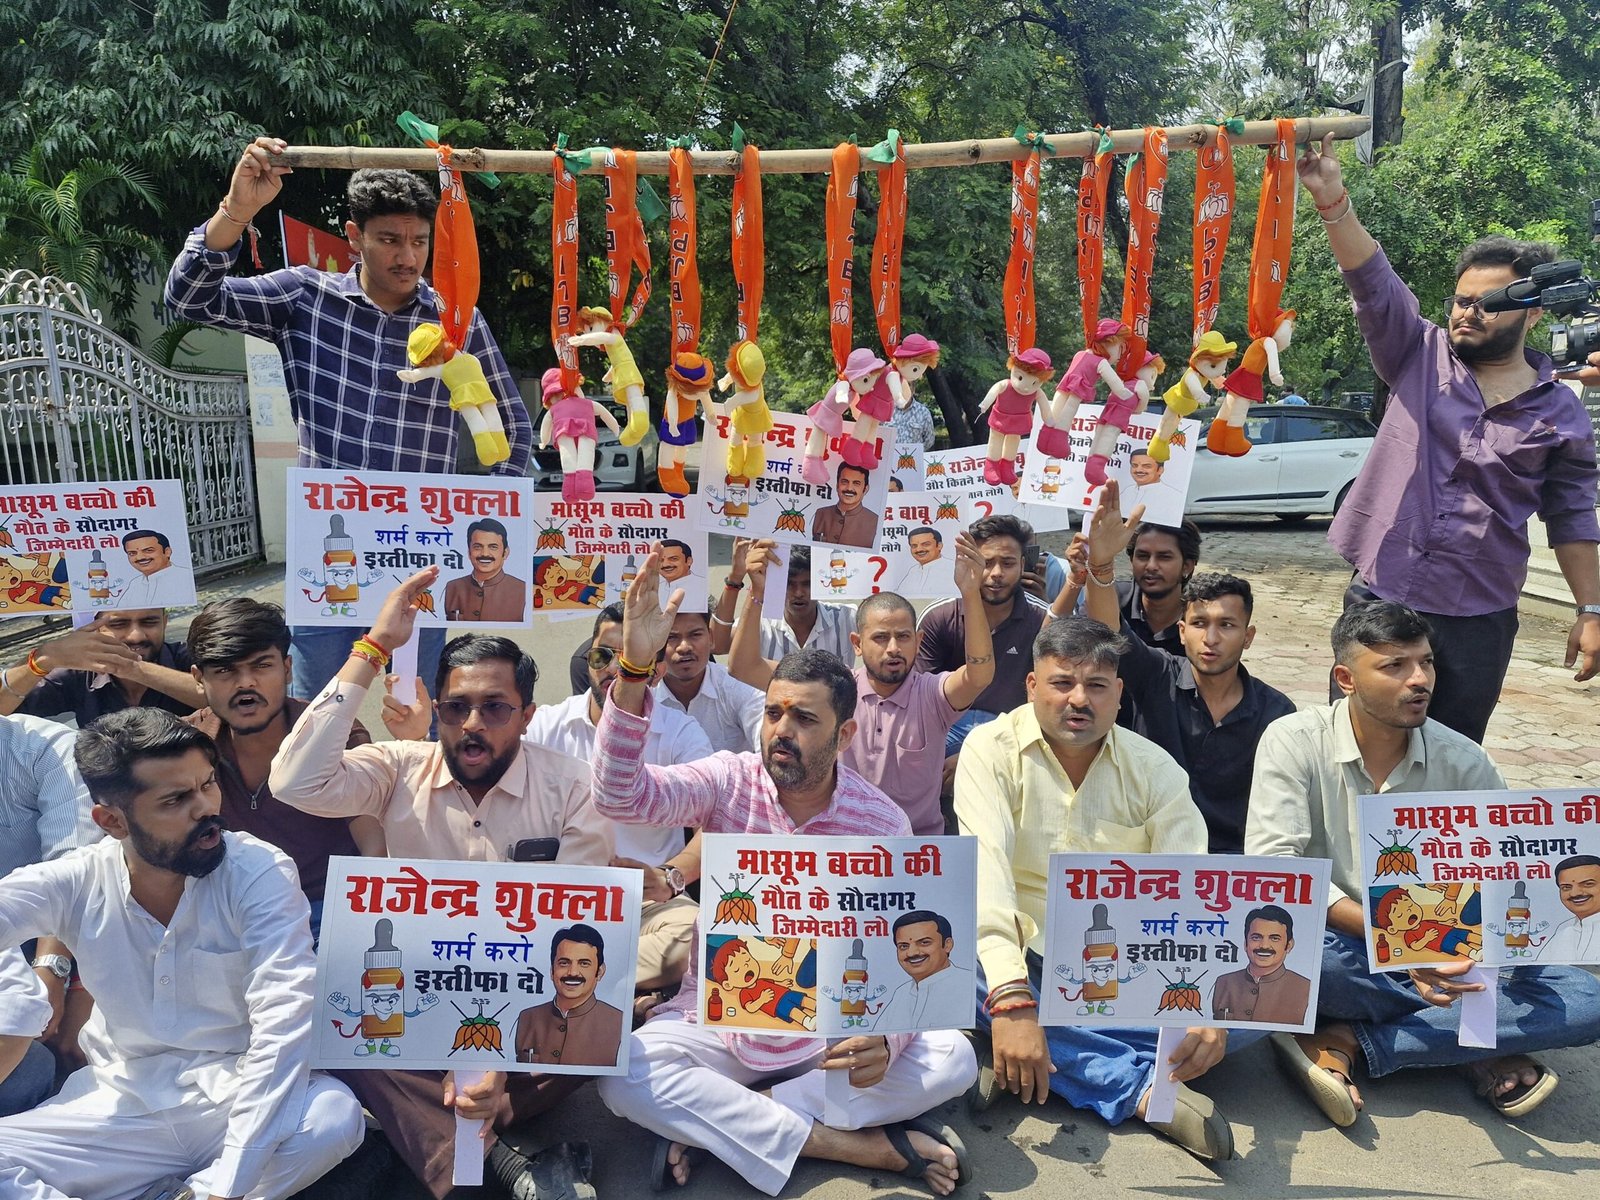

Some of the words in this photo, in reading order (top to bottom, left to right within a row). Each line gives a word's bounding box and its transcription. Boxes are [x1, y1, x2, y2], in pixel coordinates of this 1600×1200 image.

[766, 457, 793, 475] शर्म
[755, 476, 811, 497] इस्तीफा
[816, 482, 833, 500] दो
[946, 475, 974, 489] कितने
[985, 487, 1004, 497] लोगे
[63, 488, 118, 511] बच्चो
[123, 486, 157, 508] की
[303, 475, 409, 514] राजेन्द्र
[419, 487, 521, 525] शुक्ला
[551, 501, 605, 523] मासूम
[611, 498, 653, 519] बच्चो
[659, 499, 686, 519] की
[13, 519, 49, 535] मौत
[53, 518, 71, 534] के
[75, 516, 139, 533] सौदागर
[898, 505, 933, 525] बाबू
[26, 535, 96, 552] जिम्मेदारी
[99, 534, 121, 548] लो
[375, 524, 409, 546] शर्म
[416, 526, 453, 547] करो
[567, 523, 595, 538] मौत
[599, 523, 613, 538] के
[617, 523, 668, 539] सौदागर
[882, 524, 909, 540] ासूमो
[364, 547, 436, 570] इस्तीफा
[443, 550, 465, 570] दो
[575, 541, 631, 554] जिम्मेदारी
[881, 542, 901, 553] लोगे
[867, 556, 888, 594] ?
[1393, 805, 1478, 837] मासूम
[1486, 796, 1554, 827] बच्चो
[1563, 794, 1600, 824] की
[1420, 837, 1463, 859] मौत
[1470, 836, 1492, 858] के
[1499, 835, 1577, 857] सौदागर
[737, 849, 818, 885] मासूम
[826, 844, 894, 877] बच्चो
[903, 844, 942, 876] की
[1433, 862, 1520, 882] जिम्मेदारी
[1526, 860, 1551, 879] लो
[1065, 859, 1182, 901] राजेन्द्र
[1194, 869, 1313, 912] शुक्ला
[346, 866, 480, 918] राजेन्द्र
[496, 881, 625, 933] शुक्ला
[761, 885, 802, 910] मौत
[808, 886, 830, 911] के
[837, 887, 916, 911] सौदागर
[772, 914, 858, 937] जिम्मेदारी
[864, 916, 889, 937] लो
[1141, 912, 1180, 937] शर्म
[1186, 914, 1229, 937] करो
[431, 932, 478, 961] शर्म
[485, 934, 533, 963] करो
[1126, 939, 1207, 963] इस्तीफा
[1215, 940, 1239, 963] दो
[414, 964, 509, 994] इस्तीफा
[517, 967, 544, 994] दो
